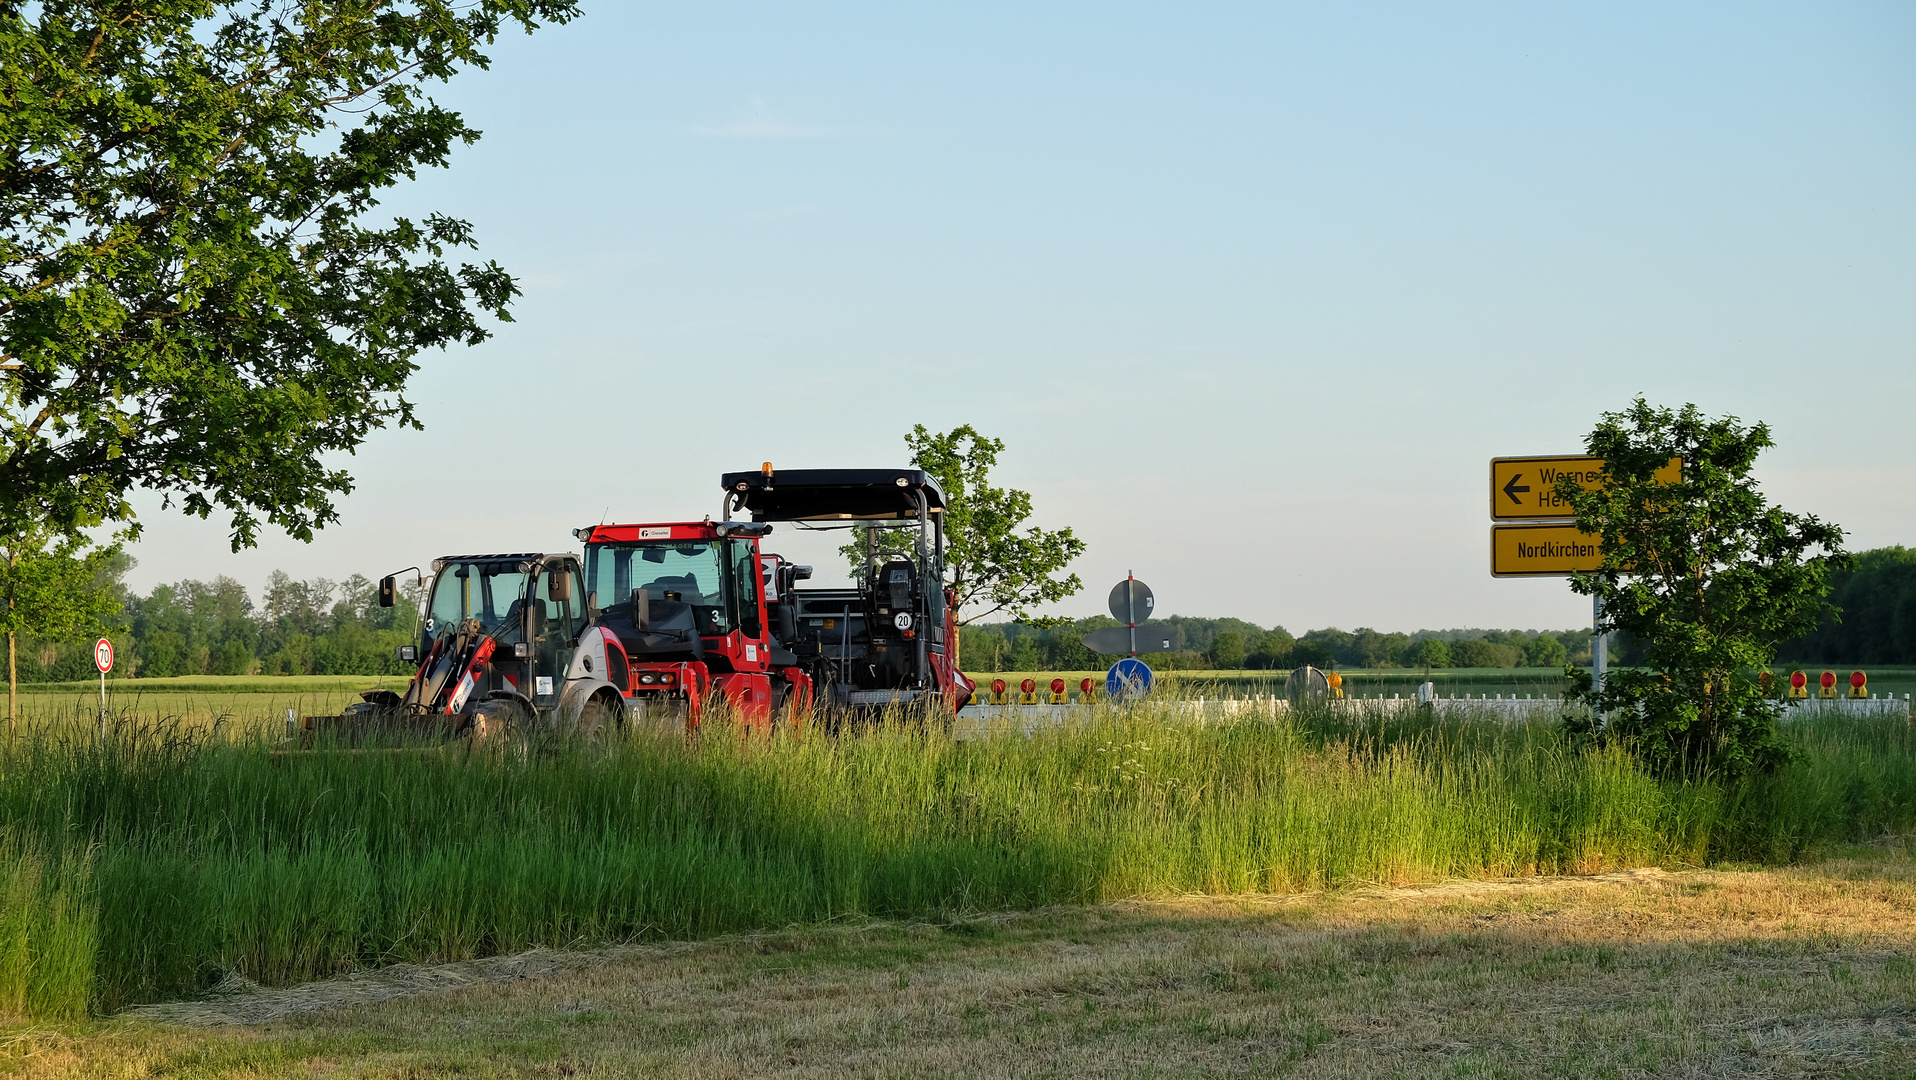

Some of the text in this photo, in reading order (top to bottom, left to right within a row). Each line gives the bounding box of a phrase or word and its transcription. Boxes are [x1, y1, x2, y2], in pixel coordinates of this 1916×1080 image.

[1539, 468, 1594, 484] Werne
[1518, 541, 1595, 558] Nordkirchen
[711, 610, 720, 623] 3
[898, 615, 909, 627] 20
[425, 619, 435, 632] 3
[100, 648, 109, 664] 70
